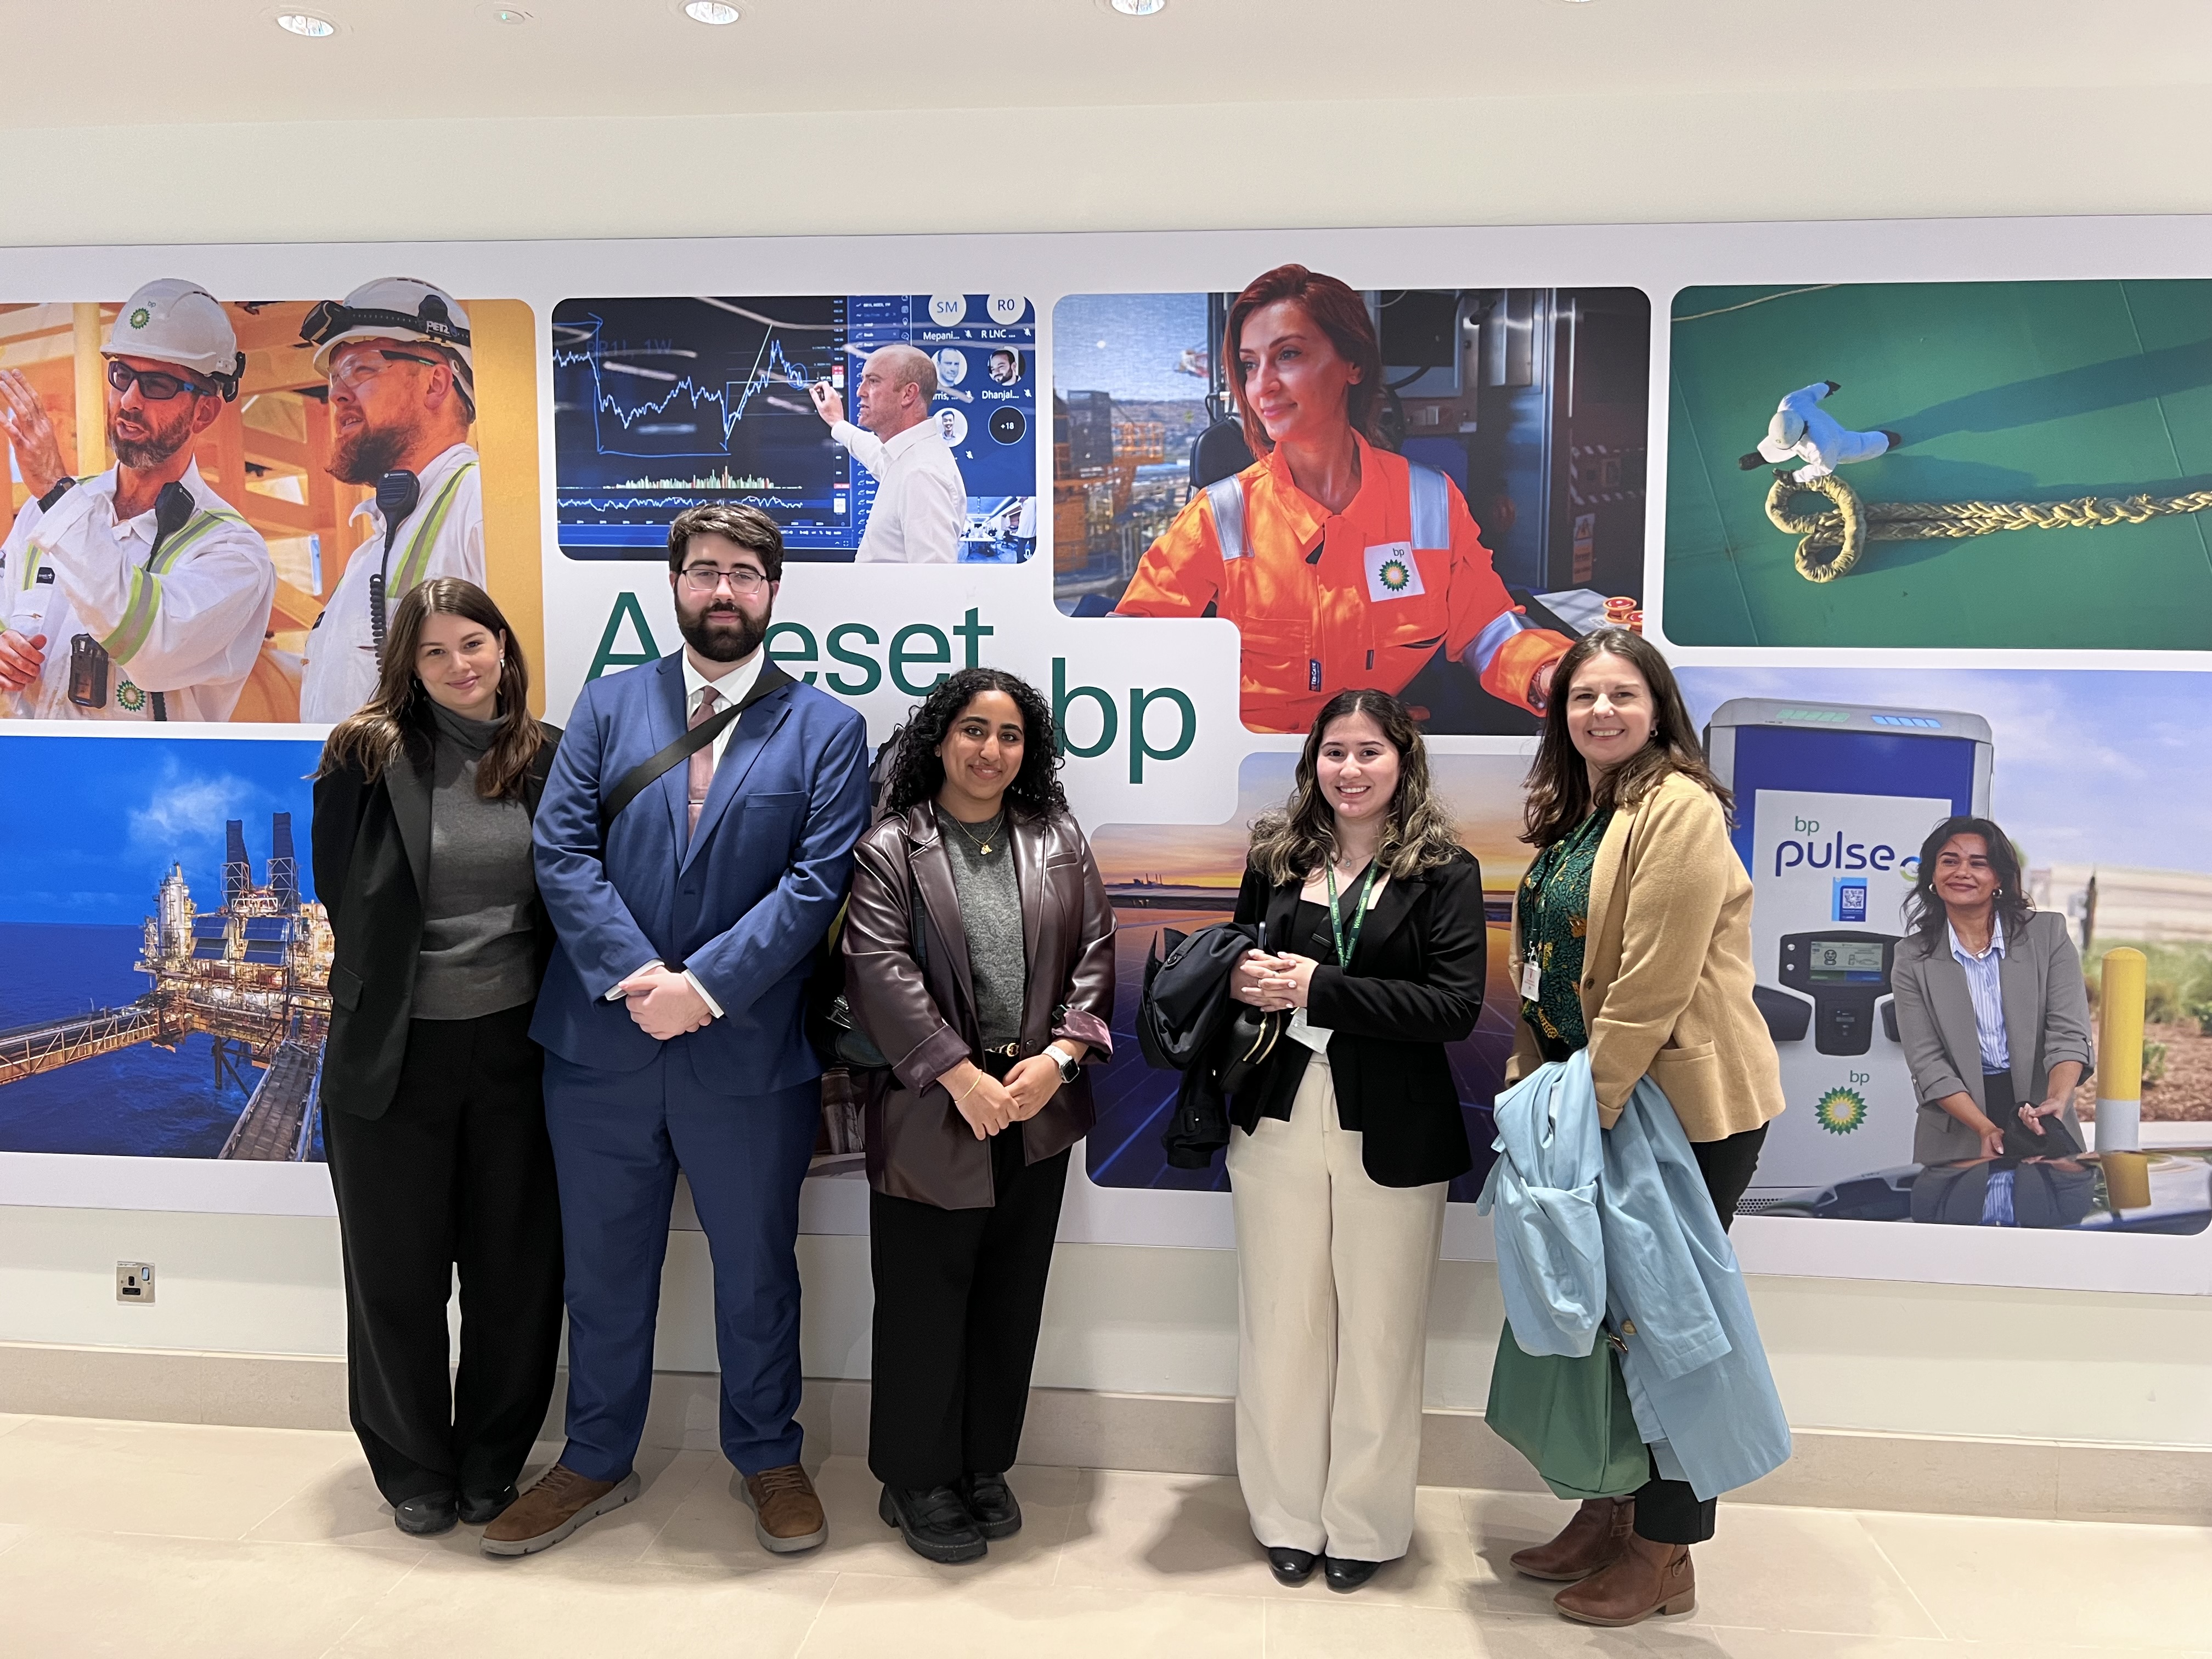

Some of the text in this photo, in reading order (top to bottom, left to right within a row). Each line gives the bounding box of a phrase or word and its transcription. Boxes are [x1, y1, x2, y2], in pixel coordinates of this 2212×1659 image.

[937, 302, 957, 313] SM
[989, 330, 1006, 338] LNC
[1001, 422, 1014, 430] +18
[1393, 548, 1404, 558] bp
[583, 592, 994, 697] A eset
[1052, 657, 1197, 785] bp
[1795, 816, 1820, 836] bp
[1775, 831, 1895, 877] pulse
[1850, 1070, 1870, 1086] bp
